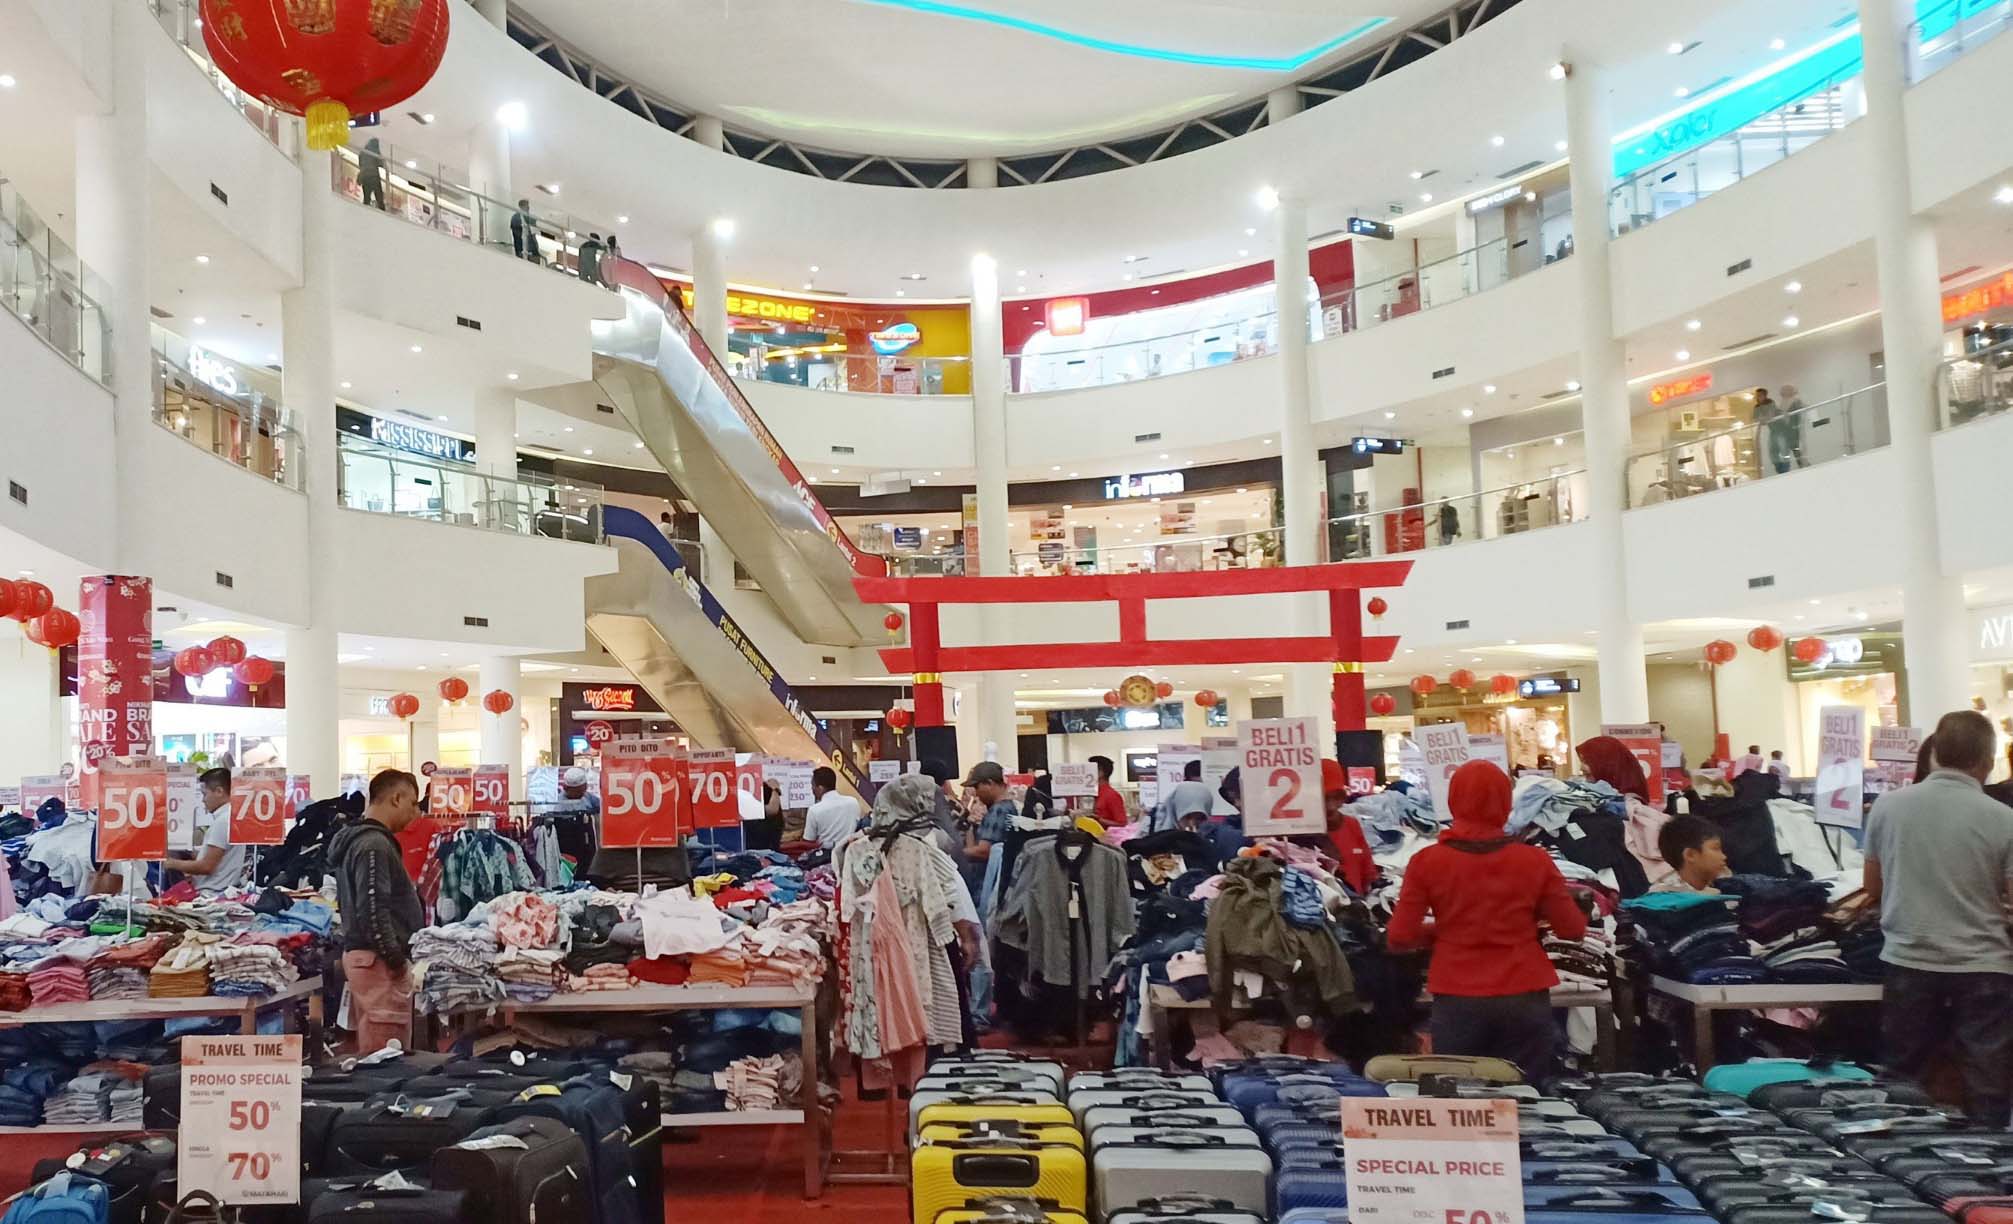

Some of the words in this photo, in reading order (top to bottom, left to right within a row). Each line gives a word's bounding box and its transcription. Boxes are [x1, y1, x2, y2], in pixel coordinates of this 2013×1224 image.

[720, 615, 741, 645] PUSAT
[740, 639, 775, 683] FURNITURE
[1252, 727, 1294, 747] BELI
[620, 744, 637, 753] PITO
[641, 744, 658, 752] DITO
[1246, 747, 1315, 768] GRATIS
[1426, 746, 1469, 765] GRATIS
[1268, 768, 1304, 819] 2
[201, 1044, 246, 1056] TRAVEL
[253, 1044, 283, 1056] TIME
[190, 1074, 236, 1086] PROMO
[239, 1073, 291, 1085] SPECIAL
[1364, 1108, 1436, 1127] TRAVEL
[1447, 1109, 1496, 1127] TIME
[1356, 1160, 1440, 1175] SPECIAL
[1445, 1161, 1505, 1176] PRICE
[1357, 1185, 1392, 1194] TRAVEL
[1395, 1186, 1416, 1194] TIME
